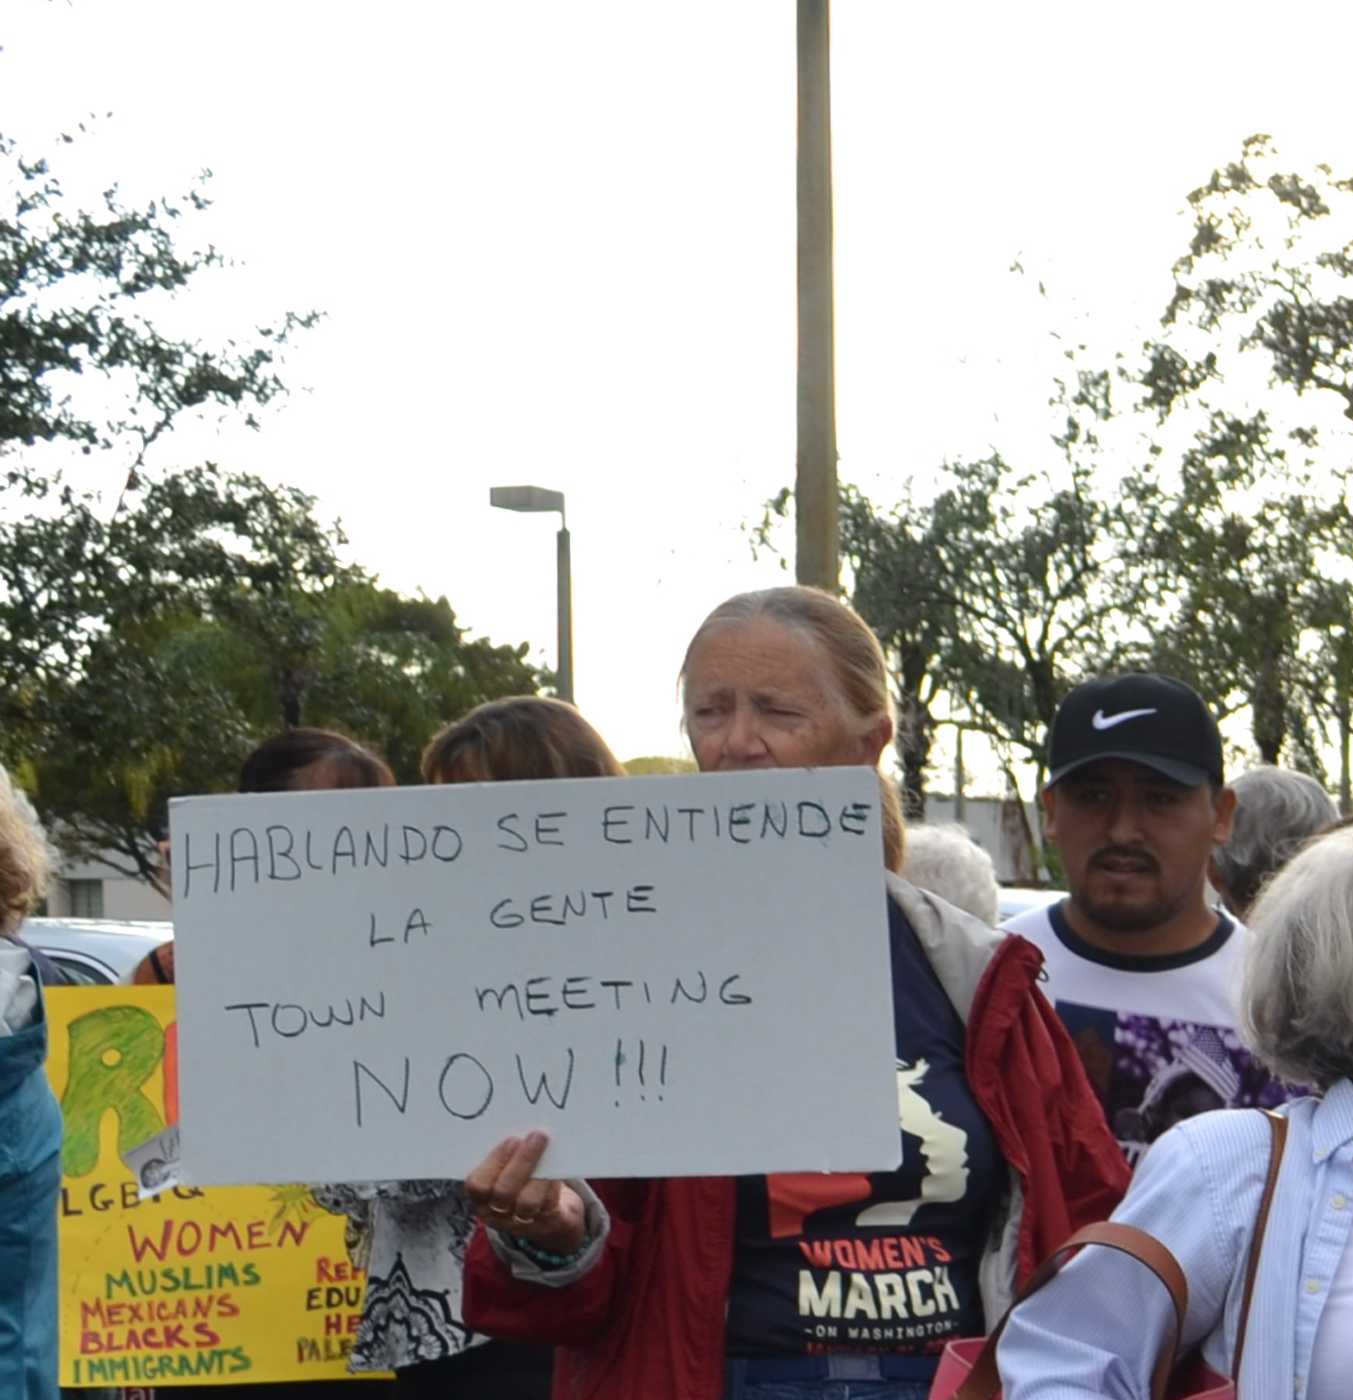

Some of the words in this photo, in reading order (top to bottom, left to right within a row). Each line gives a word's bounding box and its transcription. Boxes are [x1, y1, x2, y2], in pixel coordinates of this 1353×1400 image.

[181, 823, 463, 898] HABLANDO
[496, 812, 567, 853] SE
[602, 800, 874, 847] ENTIENDE
[369, 907, 431, 947] LA
[489, 885, 659, 929] GENTE
[226, 992, 386, 1046] TOWN
[128, 1219, 309, 1263] WOMEN
[800, 1237, 951, 1270] WOMEN'S
[106, 1263, 261, 1299] MUSLIMS
[799, 1266, 960, 1320] MARCH
[80, 1293, 240, 1330] MEXICANS
[80, 1323, 221, 1355] BLACKS
[73, 1346, 252, 1384] IMMIGRANTS
